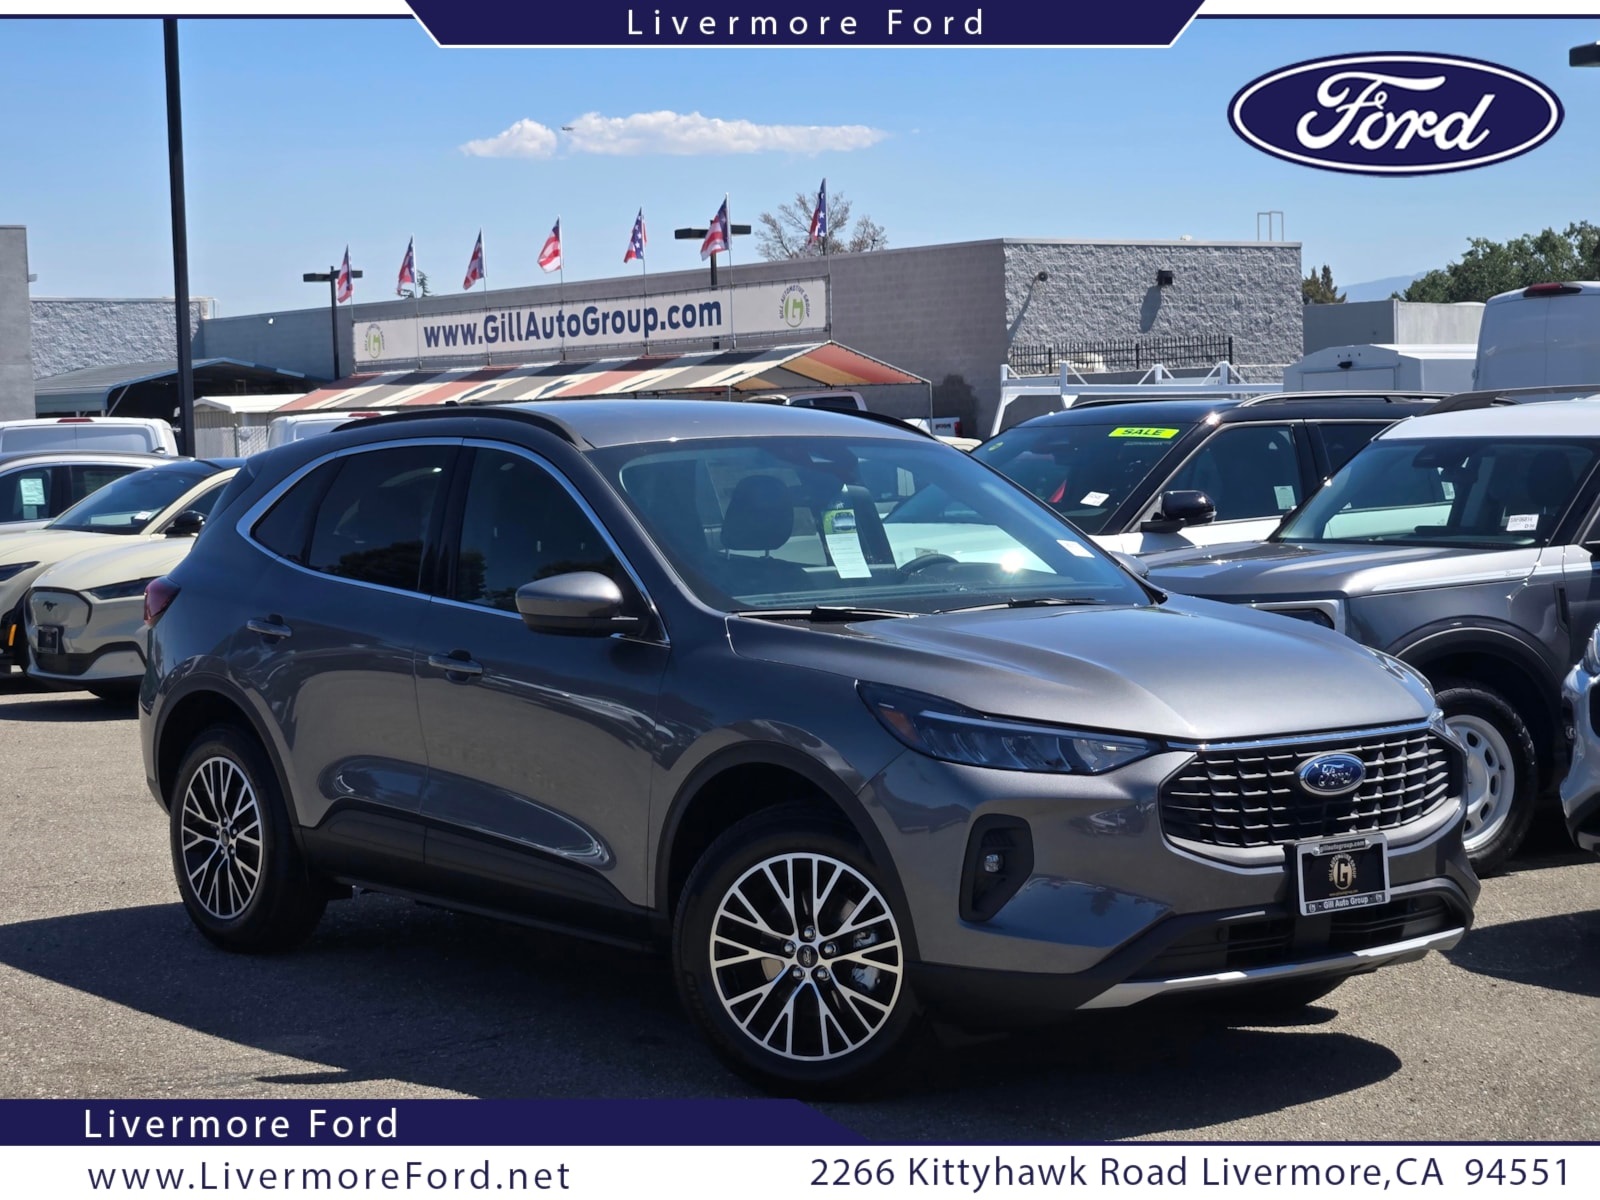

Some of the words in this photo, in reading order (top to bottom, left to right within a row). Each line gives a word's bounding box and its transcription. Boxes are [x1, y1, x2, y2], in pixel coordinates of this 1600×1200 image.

[423, 301, 722, 348] www.GillAutoGroup.com
[1121, 428, 1165, 437] SALE
[1323, 900, 1334, 909] Gill
[1335, 899, 1349, 908] Auto
[1350, 897, 1369, 905] Group
